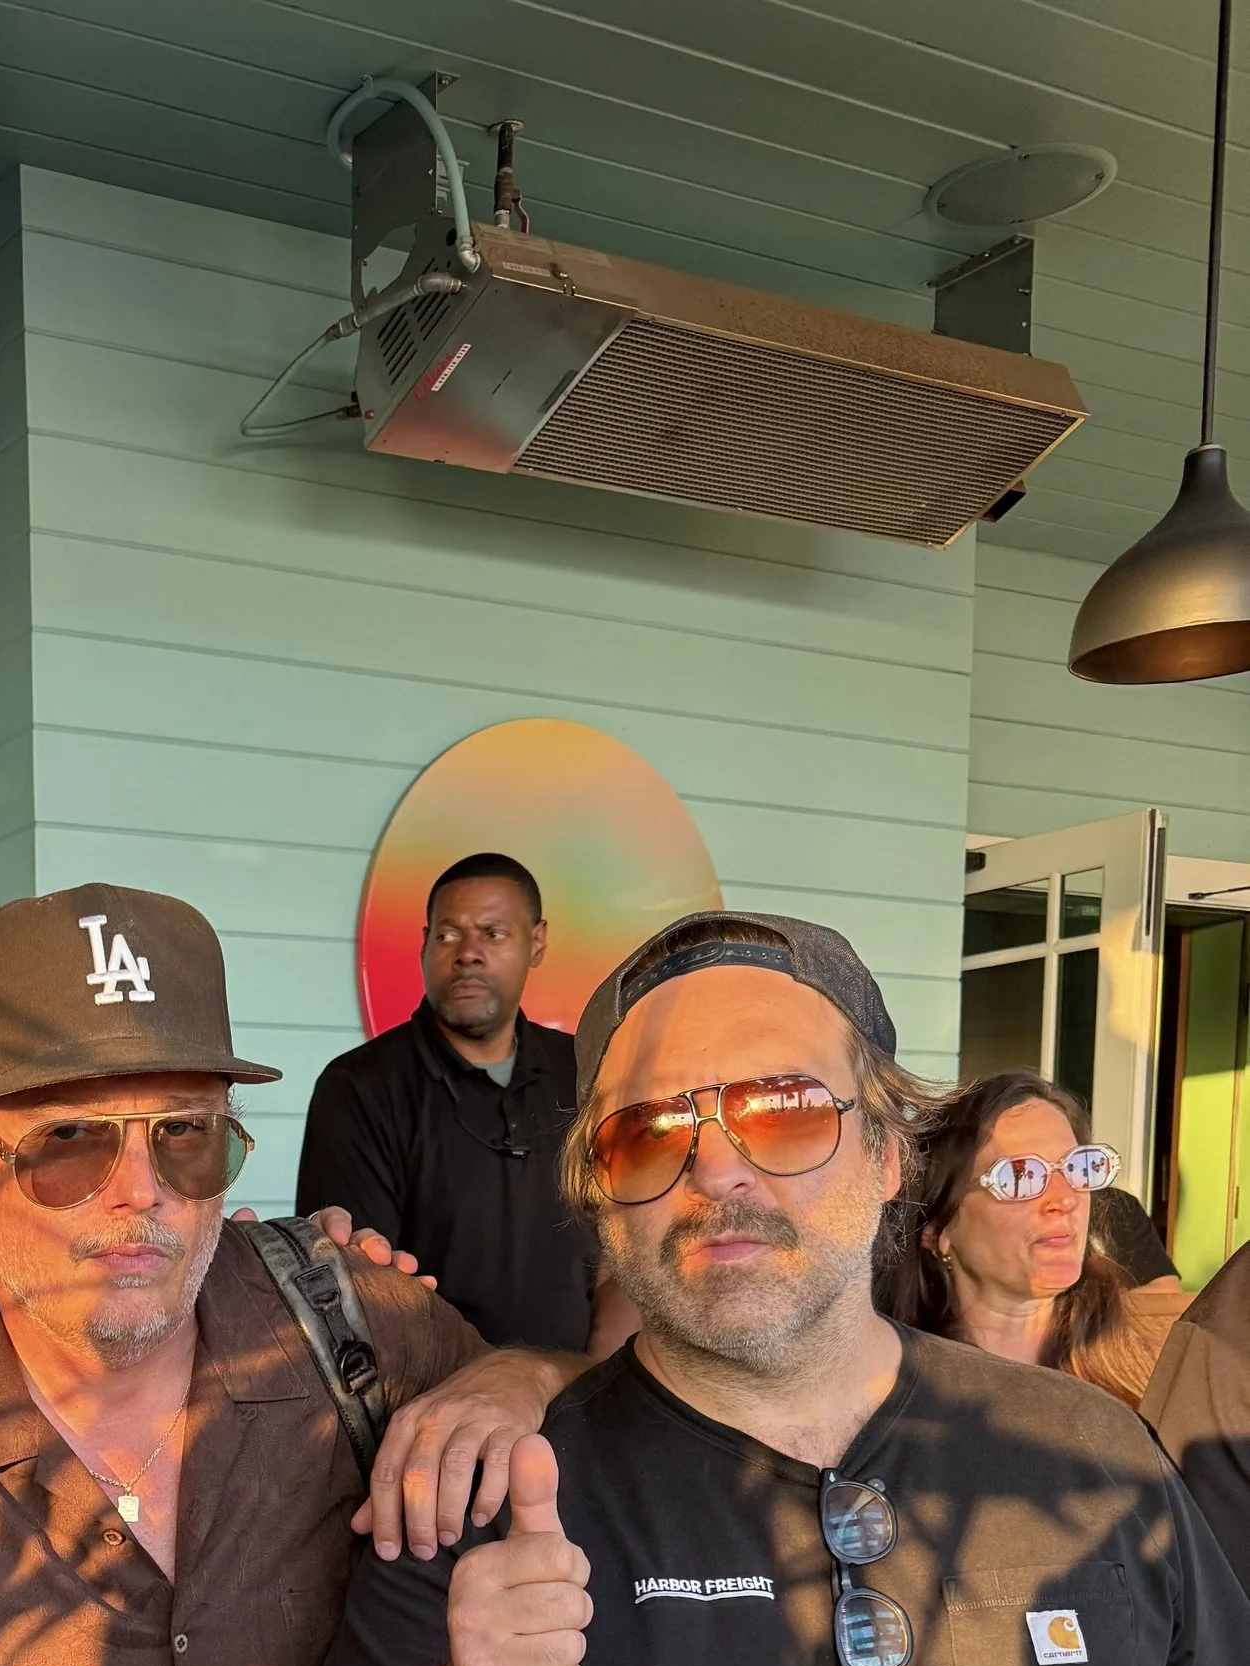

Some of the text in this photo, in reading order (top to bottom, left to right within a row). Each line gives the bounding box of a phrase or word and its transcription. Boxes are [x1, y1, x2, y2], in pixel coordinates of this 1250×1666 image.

[79, 914, 156, 1005] LA
[634, 1575, 775, 1597] HARBOR FREIGHT
